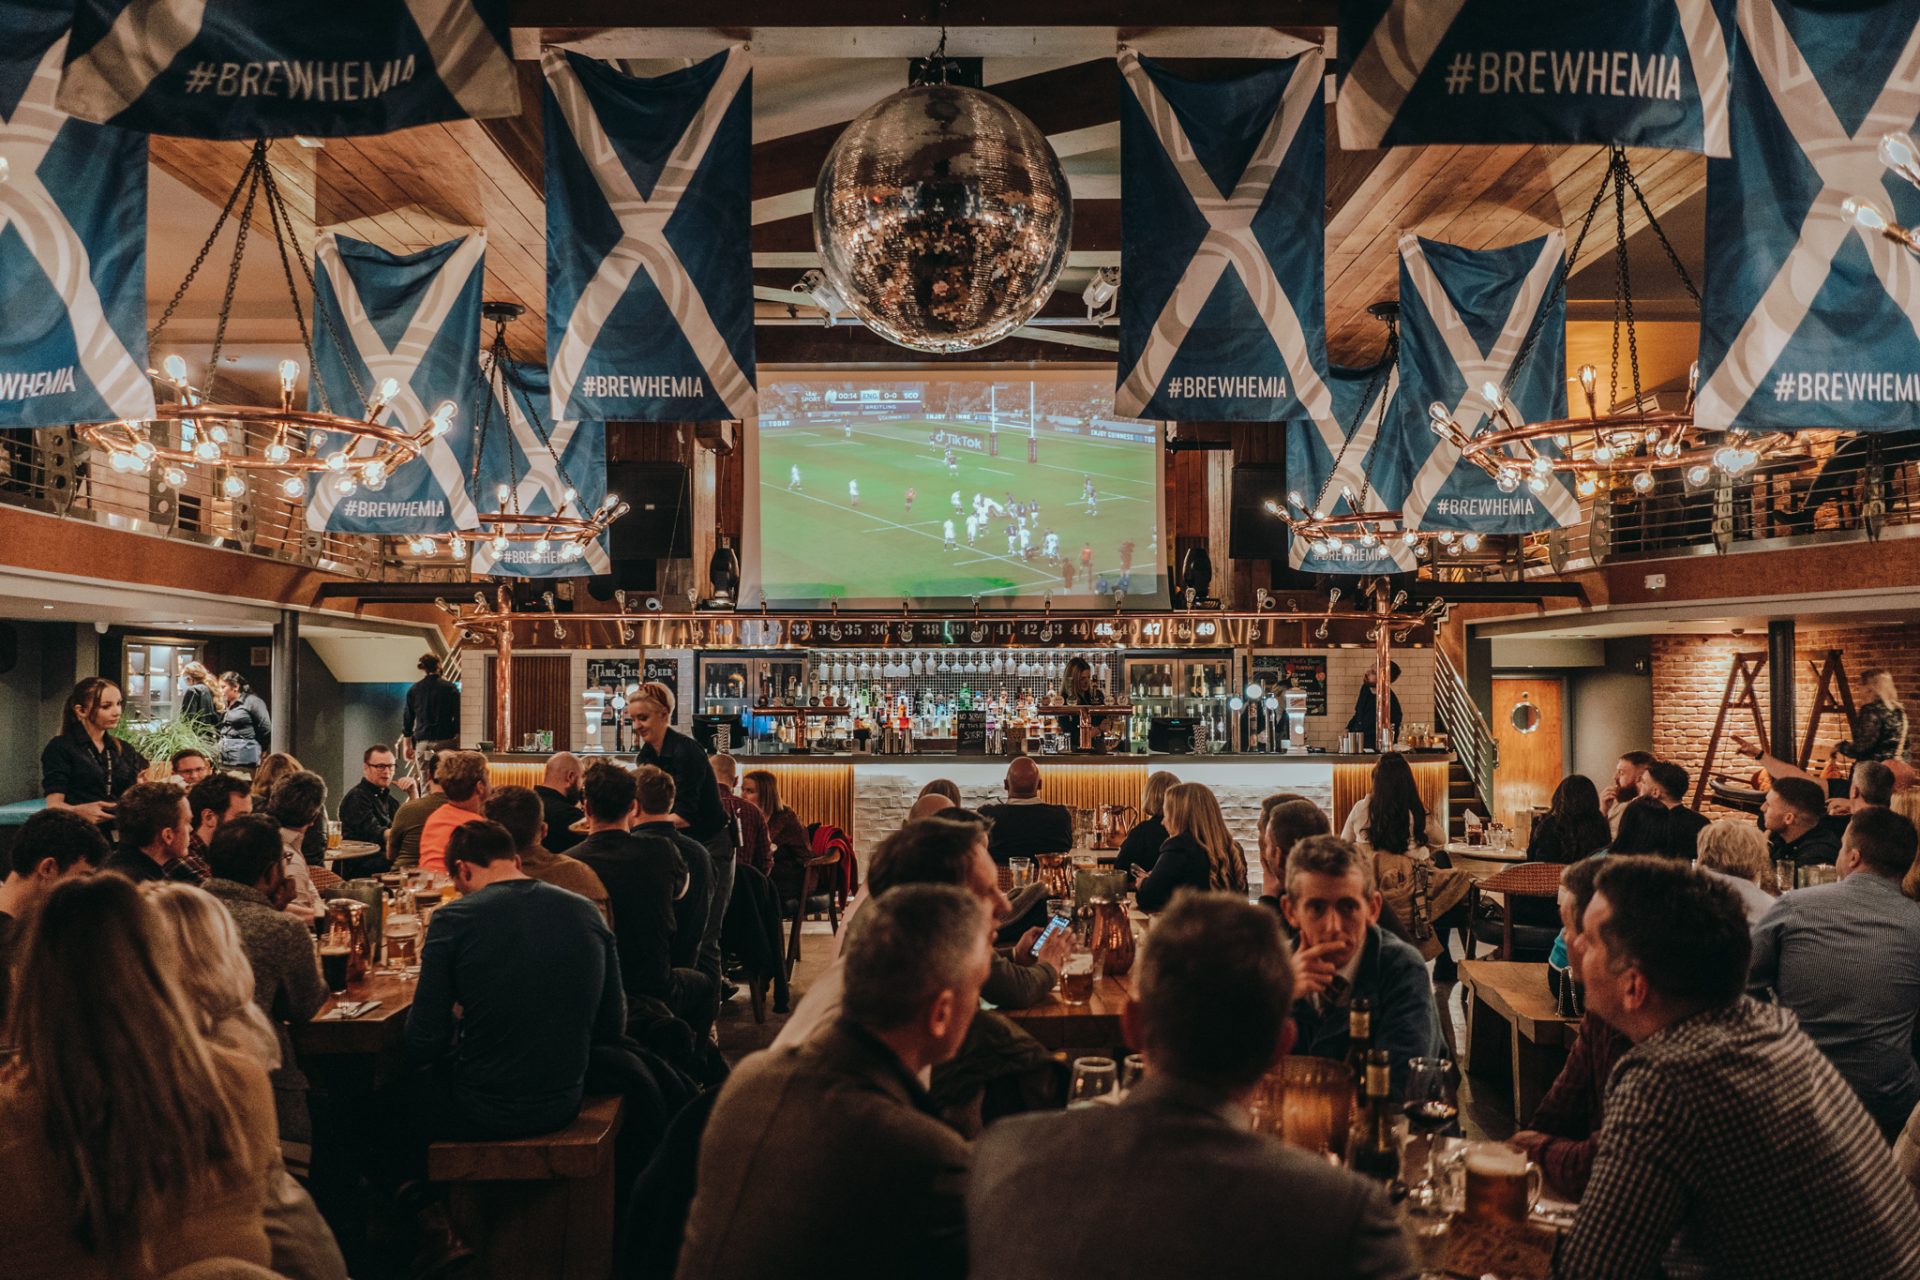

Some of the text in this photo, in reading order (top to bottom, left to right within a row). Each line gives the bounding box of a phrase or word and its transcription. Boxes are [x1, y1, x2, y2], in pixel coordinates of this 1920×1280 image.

[184, 54, 416, 101] #BREWHEMIA
[1445, 50, 1682, 101] #BREWHEMIA
[582, 375, 704, 398] #BREWHEMIA
[1168, 376, 1286, 399] #BREWHEMIA
[862, 392, 878, 400] ENG
[946, 433, 982, 449] TikTok
[344, 500, 445, 517] #BREWHEMIA
[1437, 498, 1535, 516] #BREWHEMIA
[792, 624, 808, 637] 33
[844, 624, 862, 636] 35
[871, 624, 888, 636] 36
[922, 624, 940, 636] 38
[996, 623, 1012, 636] 41
[1020, 623, 1039, 636] 42
[1069, 623, 1087, 636] 44
[1094, 623, 1114, 636] 45
[1142, 622, 1161, 636] 47
[1196, 623, 1216, 636] 49
